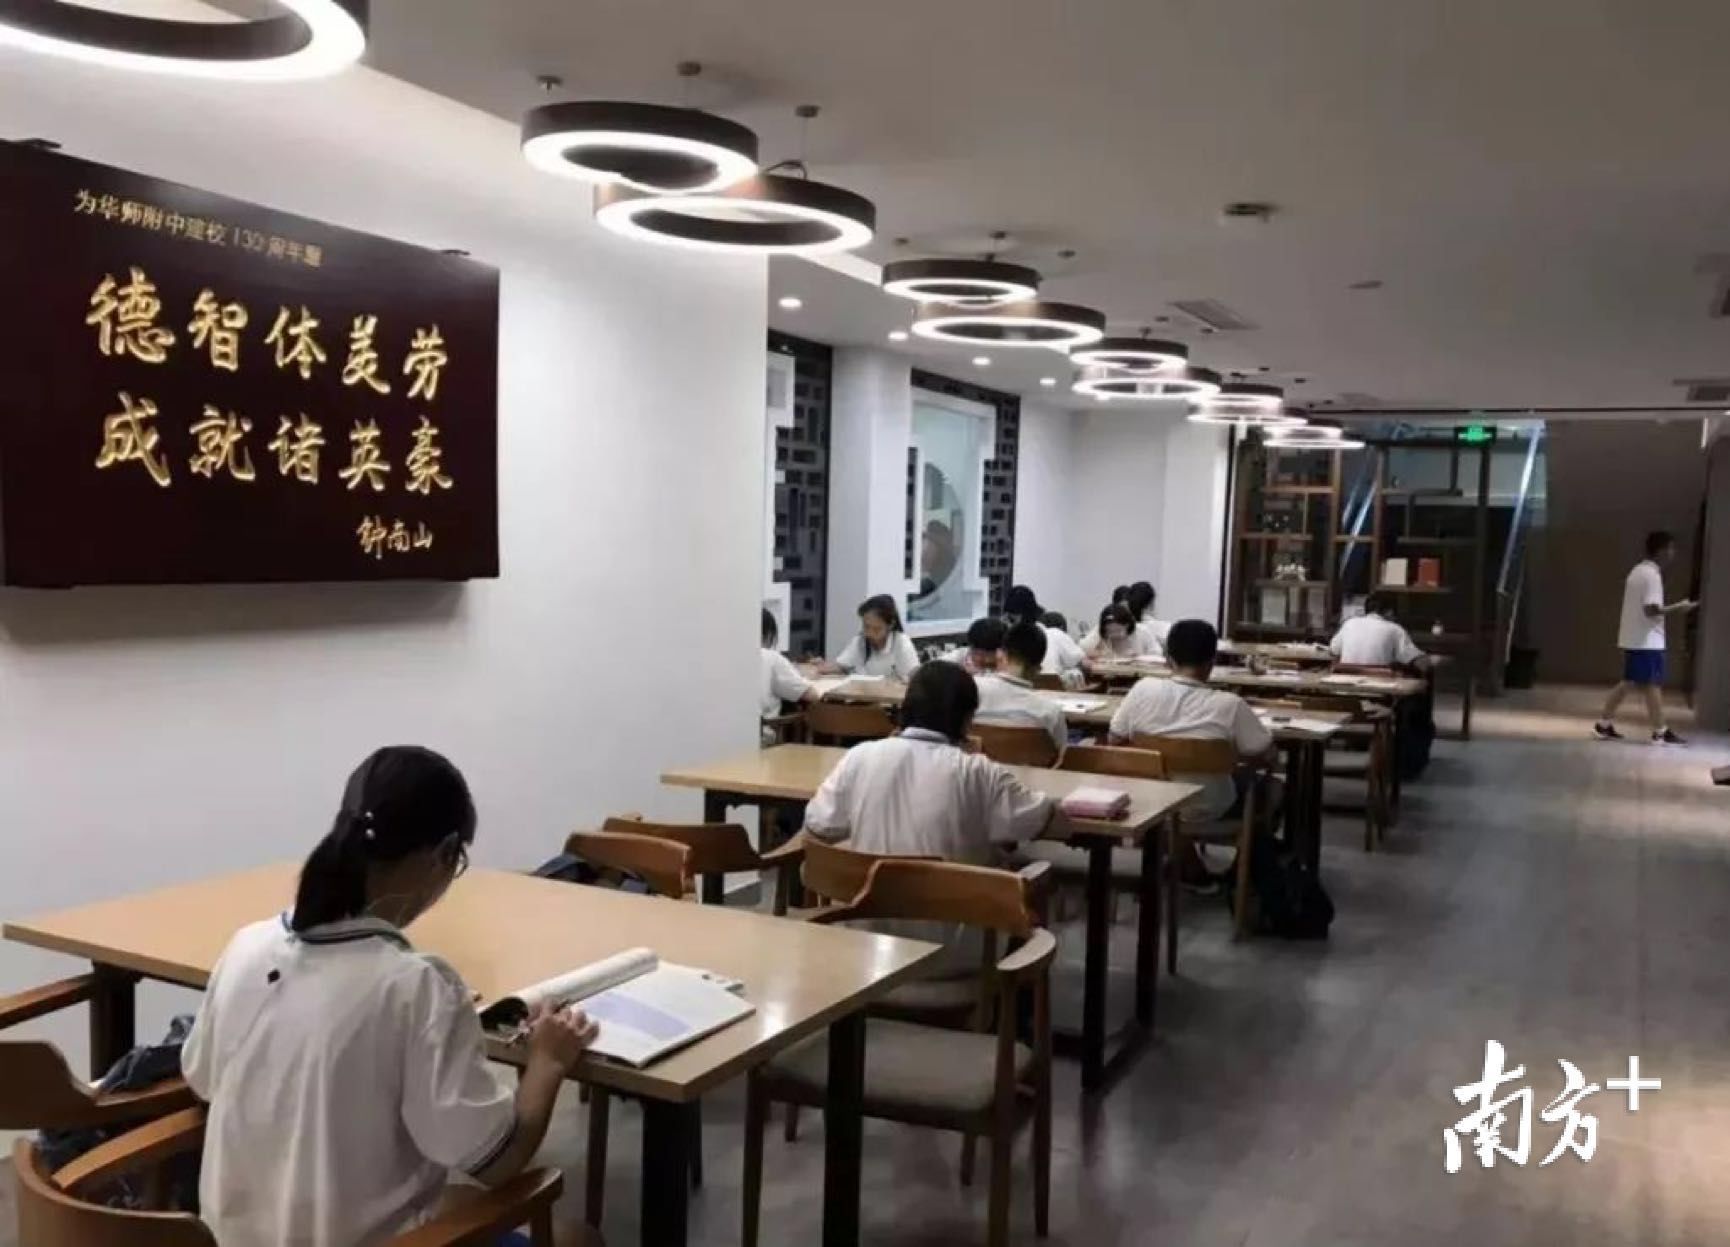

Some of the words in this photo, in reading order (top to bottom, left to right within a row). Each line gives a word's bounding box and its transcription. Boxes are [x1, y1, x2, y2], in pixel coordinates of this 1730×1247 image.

[86, 267, 449, 400] 德智体美劳
[95, 391, 453, 495] 成就诸英豪
[356, 515, 434, 559] 钟南山
